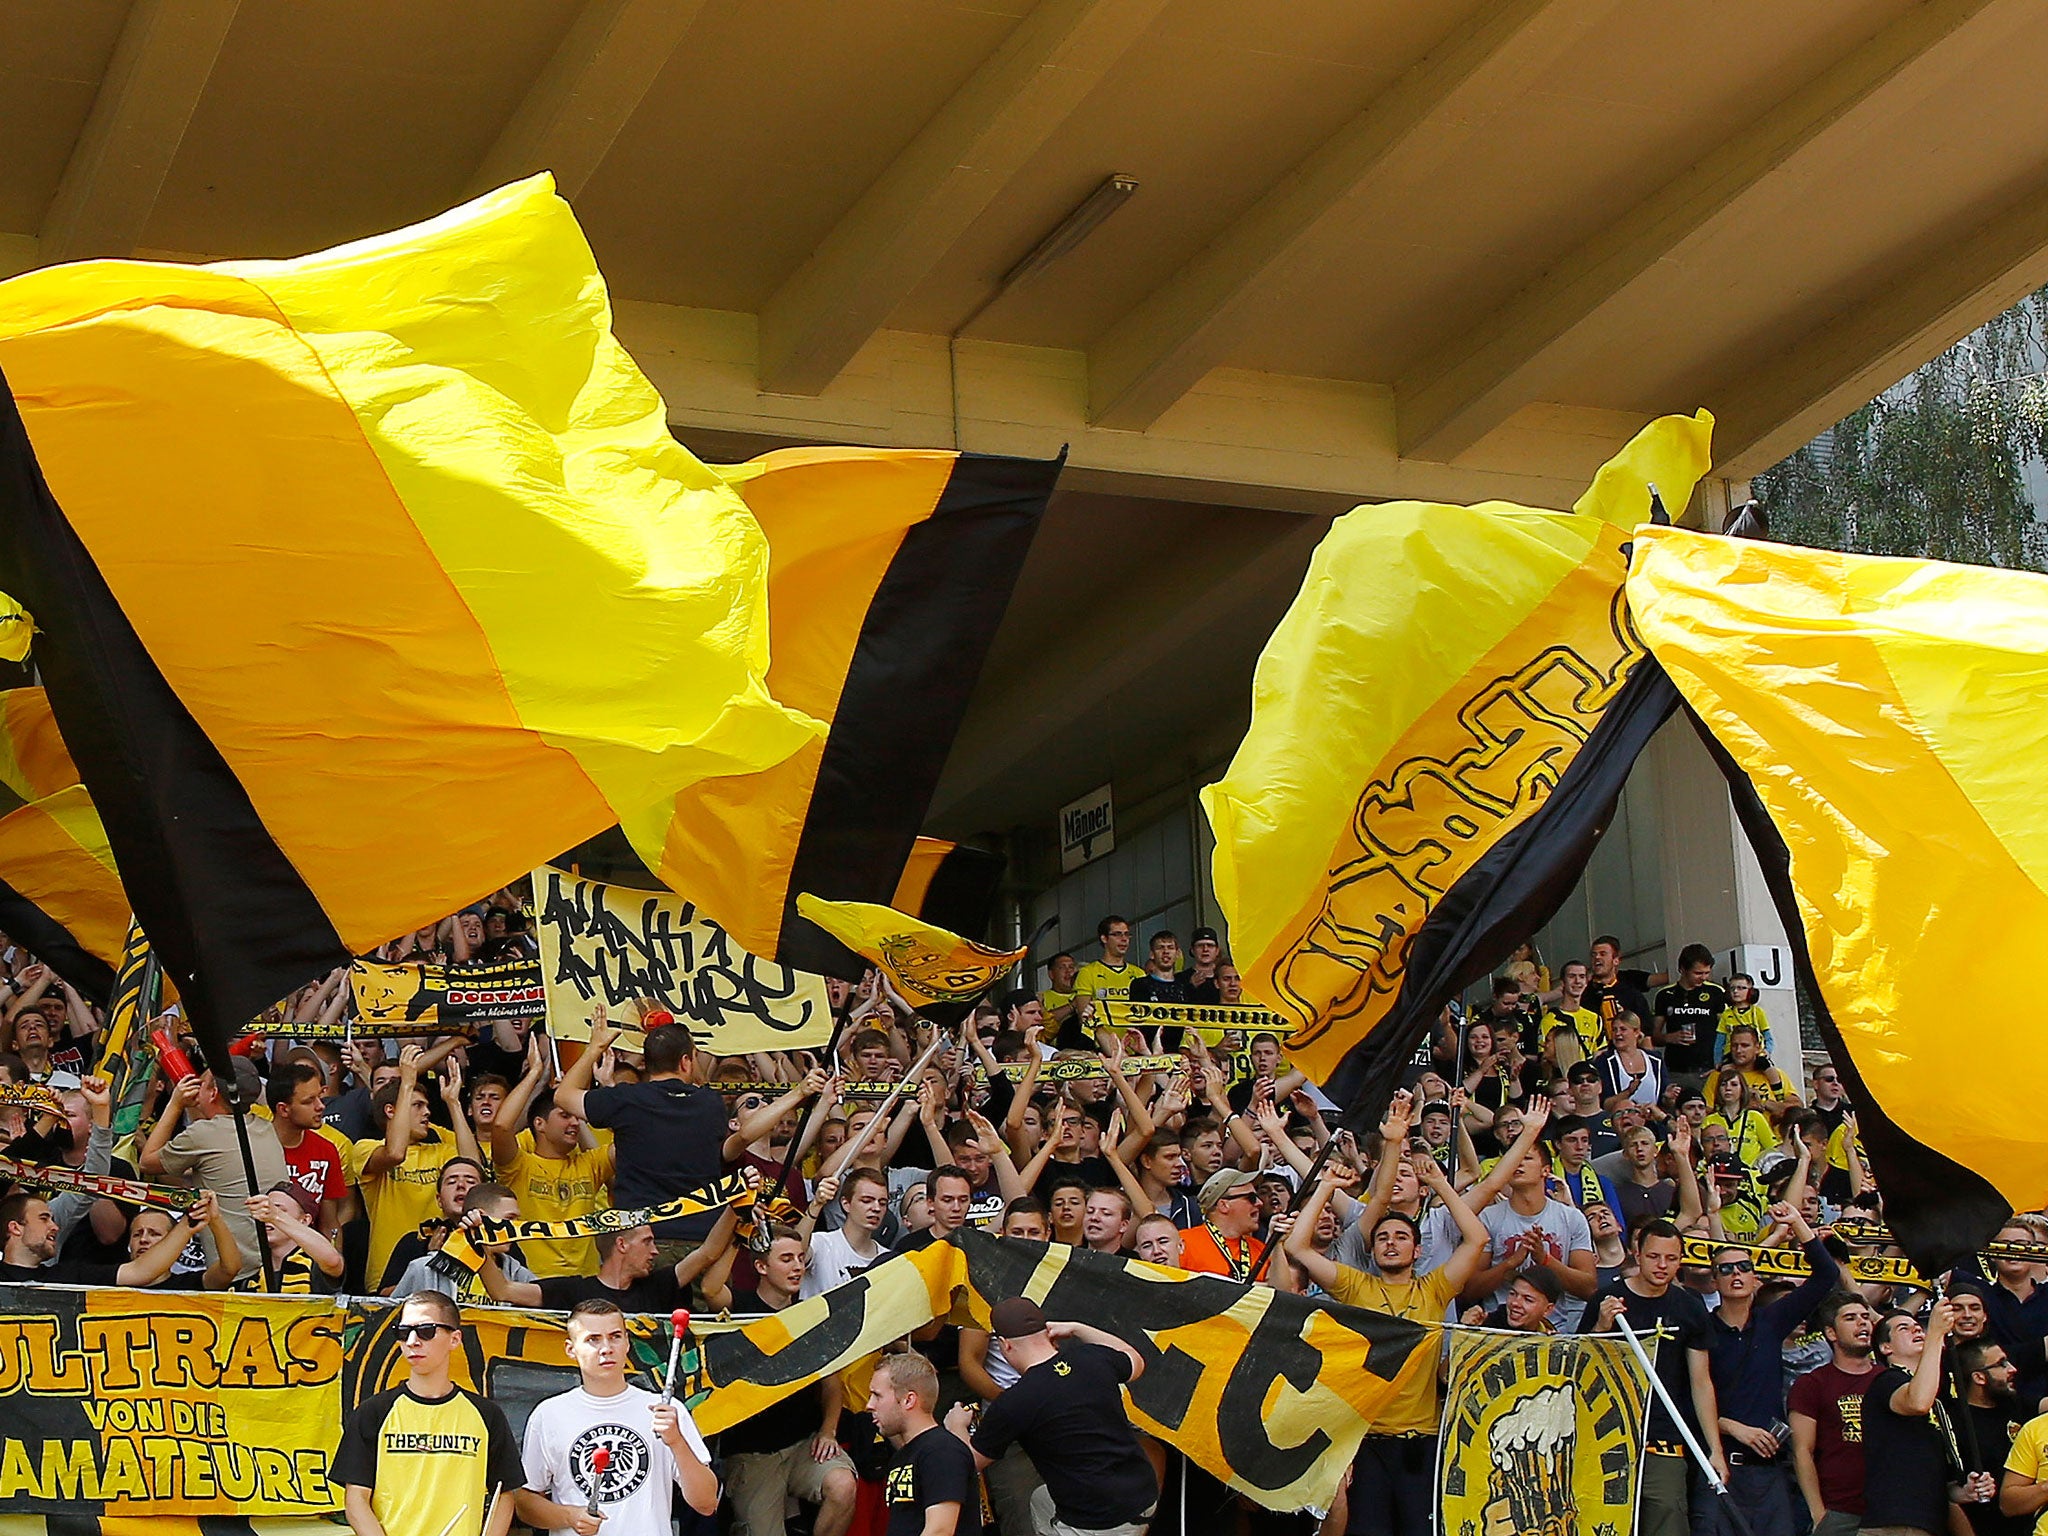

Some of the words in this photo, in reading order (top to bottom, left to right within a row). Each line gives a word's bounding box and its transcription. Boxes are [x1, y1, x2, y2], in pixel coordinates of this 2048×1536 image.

[1064, 801, 1110, 845] Männer
[424, 959, 542, 977] BALLSPIEL
[1760, 948, 1780, 986] J
[1107, 988, 1131, 998] EVO
[488, 1007, 518, 1017] kleines
[520, 1004, 546, 1015] bissch
[82, 1397, 165, 1432] VON
[171, 1399, 229, 1438] DIE
[385, 1433, 417, 1449] THE
[433, 1434, 481, 1452] UNITY
[588, 1426, 647, 1455] DORTMUND
[0, 1436, 336, 1505] AMATEURE
[612, 1469, 646, 1501] NAZIS
